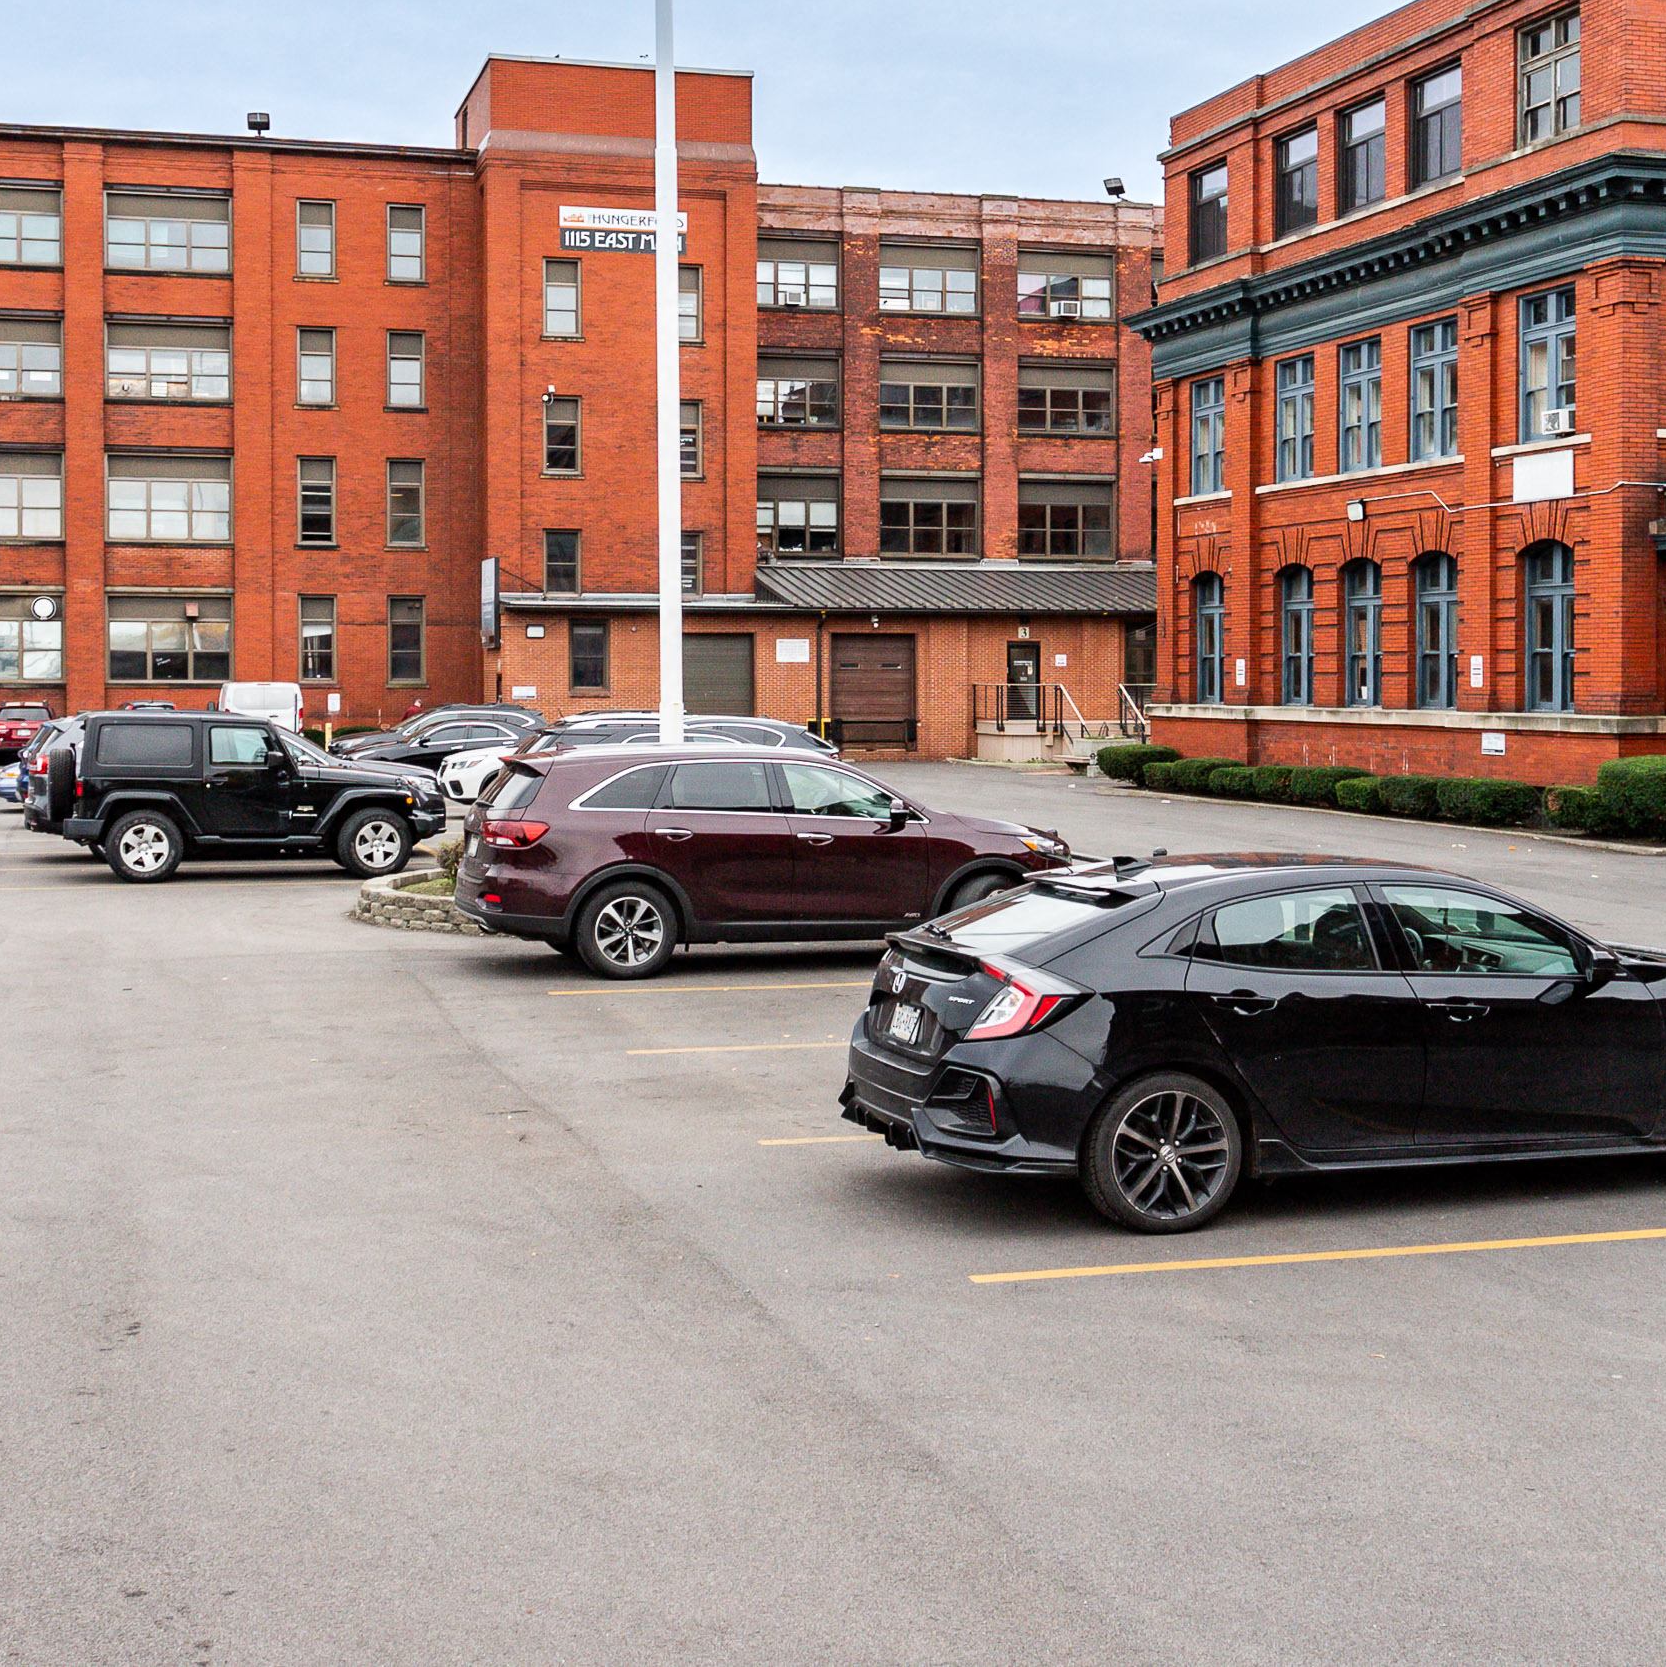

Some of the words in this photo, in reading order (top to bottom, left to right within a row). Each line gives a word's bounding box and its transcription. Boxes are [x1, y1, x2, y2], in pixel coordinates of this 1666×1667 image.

[564, 230, 591, 247] 1115
[594, 231, 637, 249] EAST
[1021, 627, 1028, 638] 3
[948, 995, 975, 1005] SPORT
